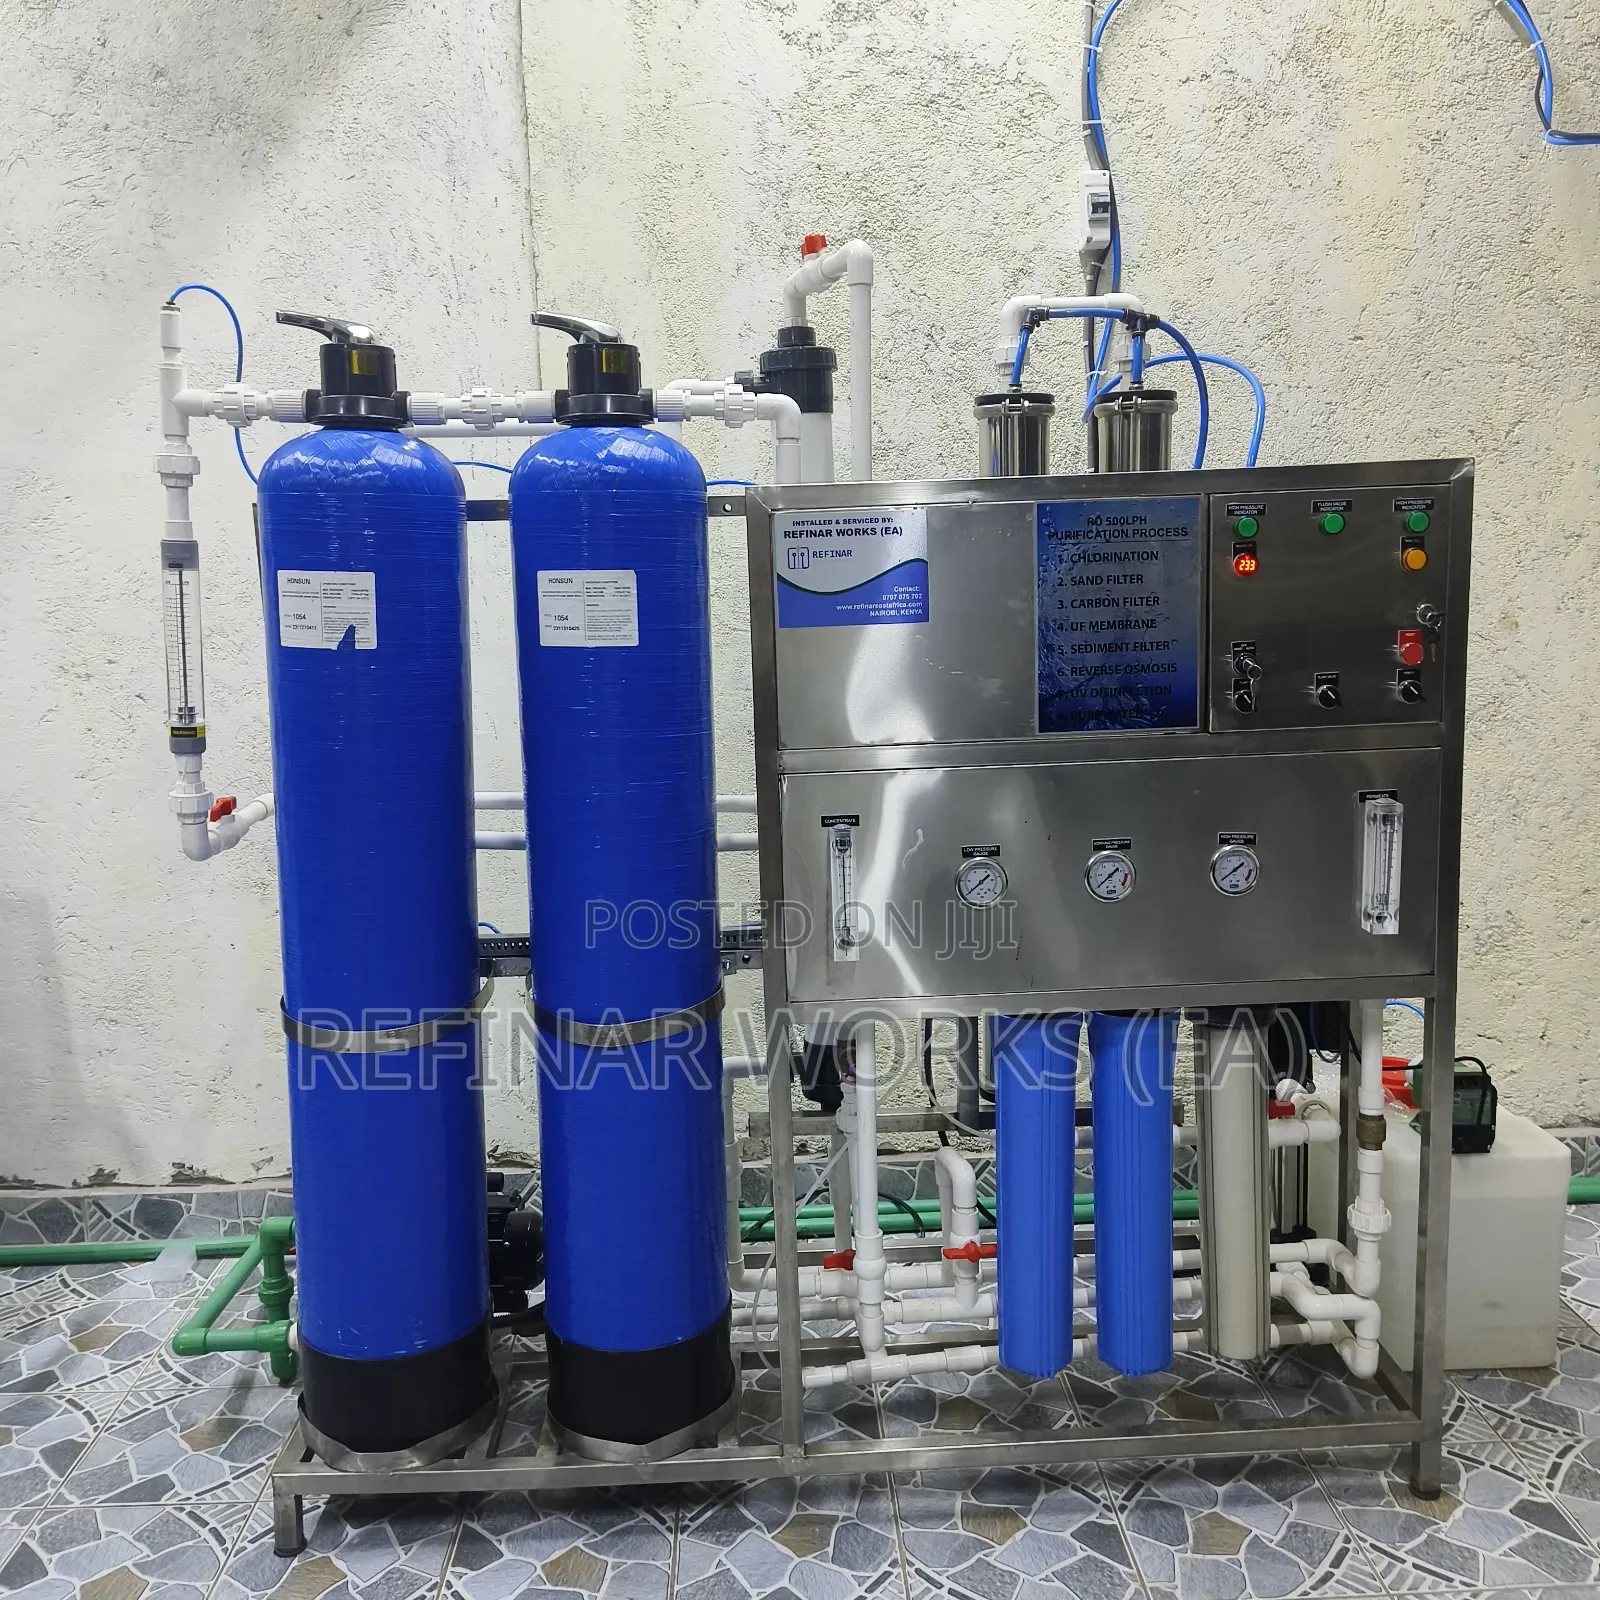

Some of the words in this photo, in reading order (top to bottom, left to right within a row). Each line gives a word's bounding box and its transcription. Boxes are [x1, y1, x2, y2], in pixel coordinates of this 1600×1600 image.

[1087, 516, 1102, 526] RO
[1105, 516, 1147, 526] 500LPH
[784, 529, 833, 539] REFINAR
[836, 528, 877, 538] WORKS
[880, 526, 903, 538] (EA)
[1048, 528, 1130, 541] PURIFICATION
[1132, 527, 1188, 538] PROCESS
[812, 550, 853, 558] REFINAR
[1070, 550, 1158, 563] CHLORINATION
[1239, 560, 1256, 570] 233
[1057, 577, 1067, 586] 2.
[1070, 576, 1103, 586] SAND
[1106, 574, 1144, 584] FILTER
[836, 602, 923, 610] www.refinareastafrica.com
[1057, 600, 1068, 610] 3.
[1070, 598, 1120, 609] CARBON
[1123, 596, 1160, 607] FILTER
[1056, 622, 1068, 632] 4.
[1070, 622, 1086, 632] UF
[1089, 619, 1157, 632] MEMBRANE
[1057, 645, 1068, 656] 5.
[1070, 642, 1130, 654] SEDIMENT
[1133, 641, 1170, 652] FILTER
[1057, 668, 1068, 677] 6.
[1070, 665, 1121, 677] REVERSE
[1124, 663, 1178, 674] OSMOSIS
[1070, 688, 1088, 699] UV
[1090, 686, 1172, 698] DISINFECTION
